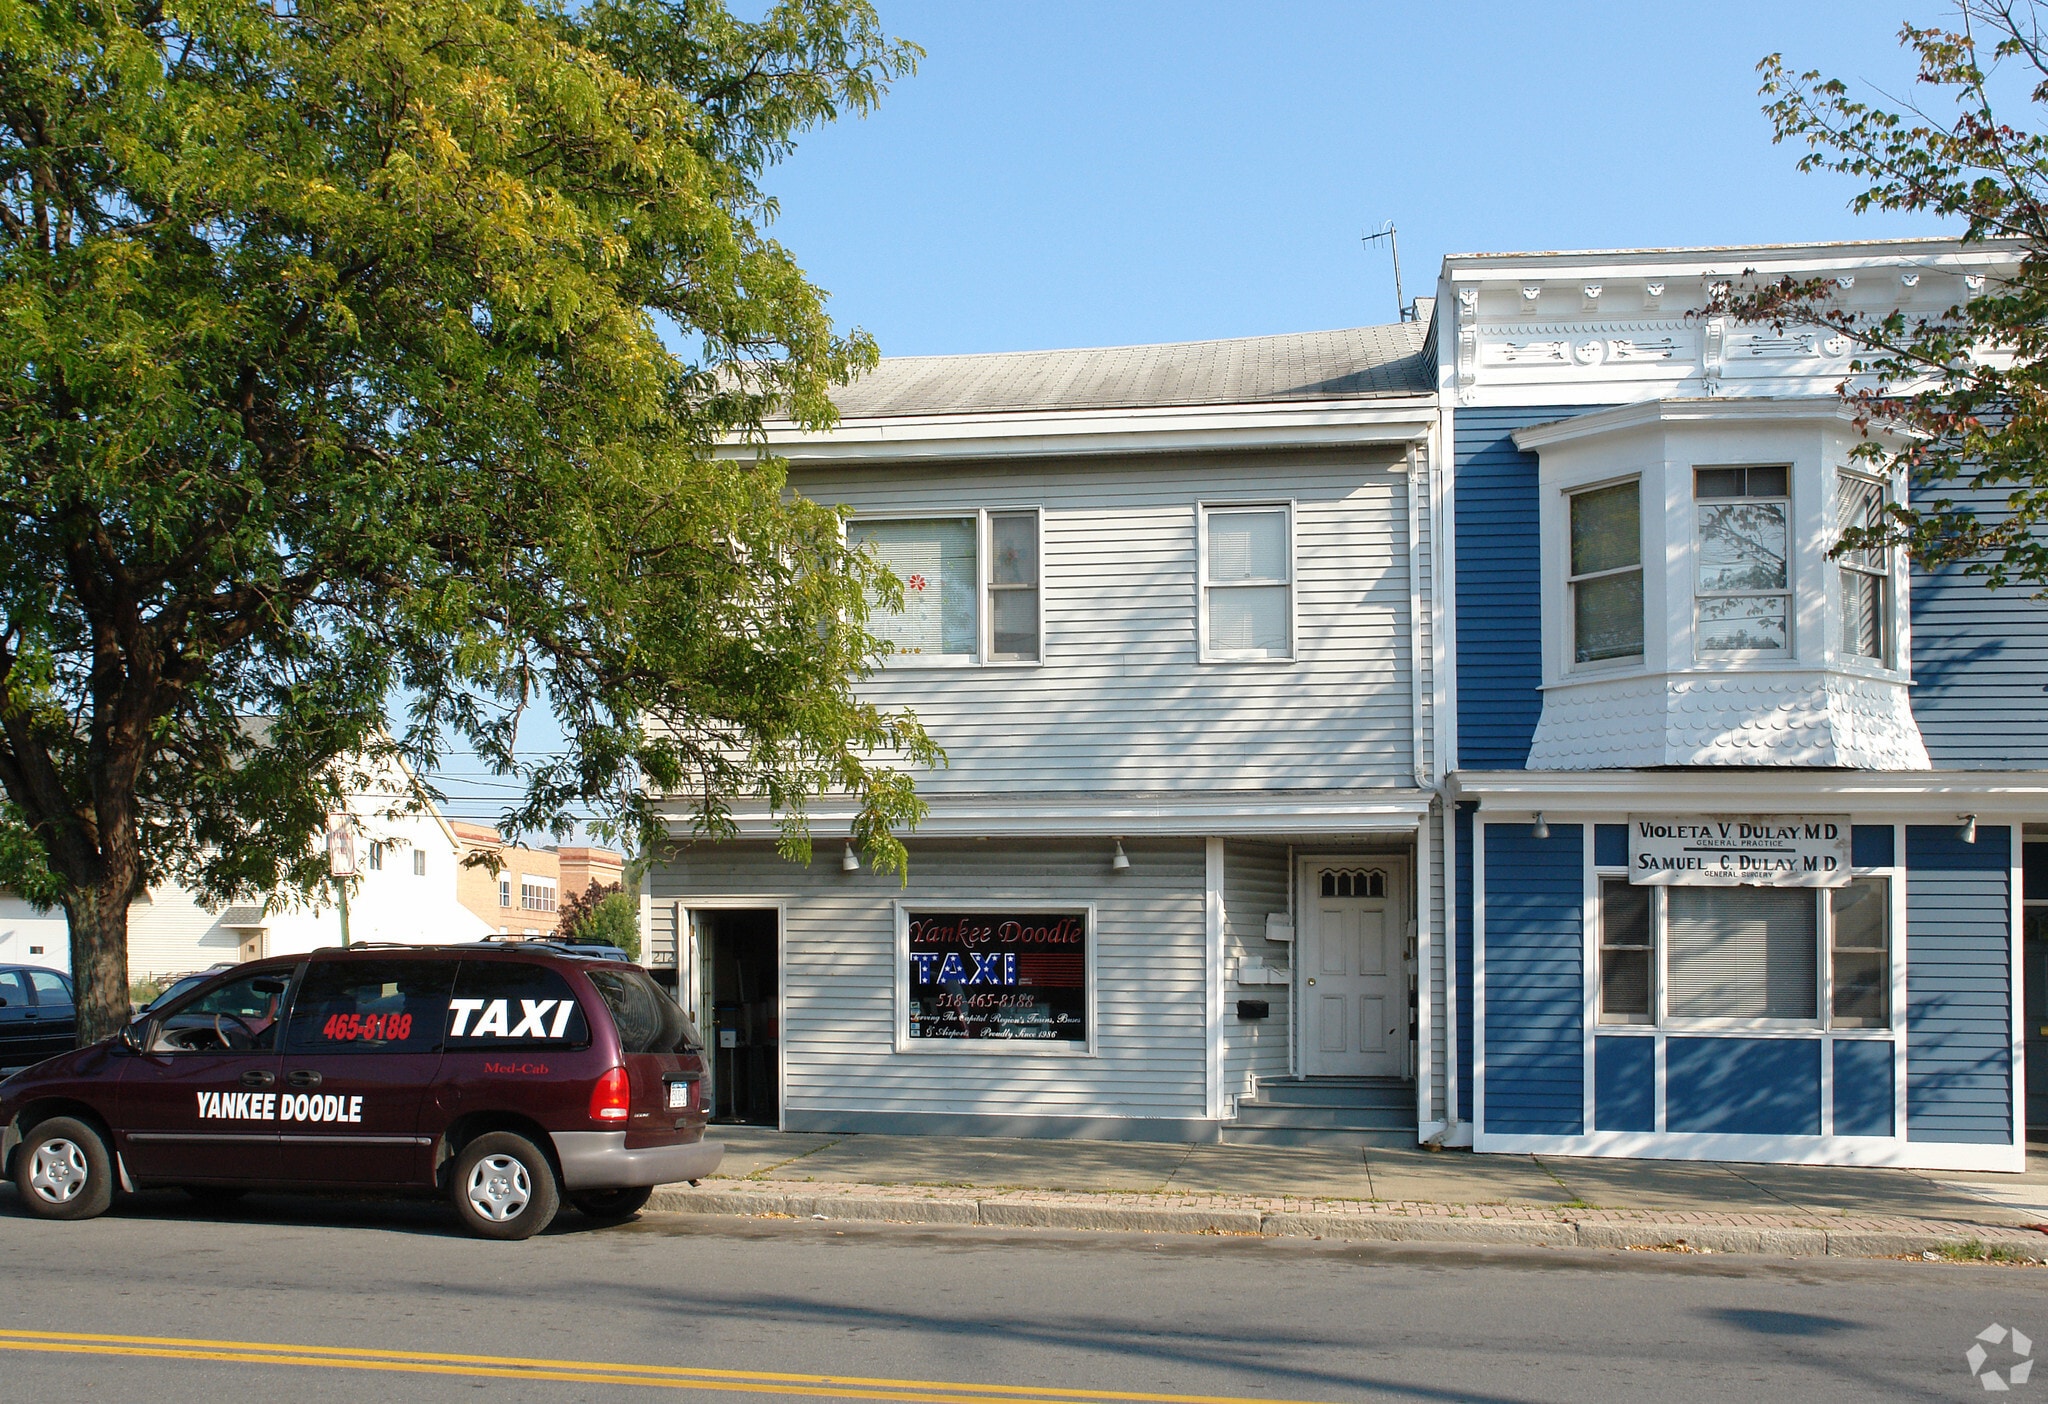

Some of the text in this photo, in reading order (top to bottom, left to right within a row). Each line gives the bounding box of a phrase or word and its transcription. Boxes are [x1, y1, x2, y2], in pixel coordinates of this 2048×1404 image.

[1639, 822, 1839, 840] VIOLETA V. DULAY, M.D.
[1696, 839, 1784, 848] GENERAL PRACTICE
[1638, 853, 1840, 872] SAMUEL C. DULAY, M.D.
[1704, 870, 1738, 878] GENERAL
[909, 918, 1083, 949] Yankee Doodle
[910, 952, 1017, 986] TAXI
[935, 992, 1035, 1009] 518-465-8188
[323, 1013, 413, 1040] 465-8188
[449, 998, 575, 1038] TAXI
[942, 1011, 958, 1023] The
[959, 1012, 987, 1025] Capital
[990, 1012, 1025, 1026] Region's
[1056, 1012, 1082, 1024] Buses
[925, 1025, 1058, 1040] & Airports Proudly Since 1986
[484, 1062, 549, 1075] Med-Cab
[197, 1091, 363, 1123] YANKEE DOODLE
